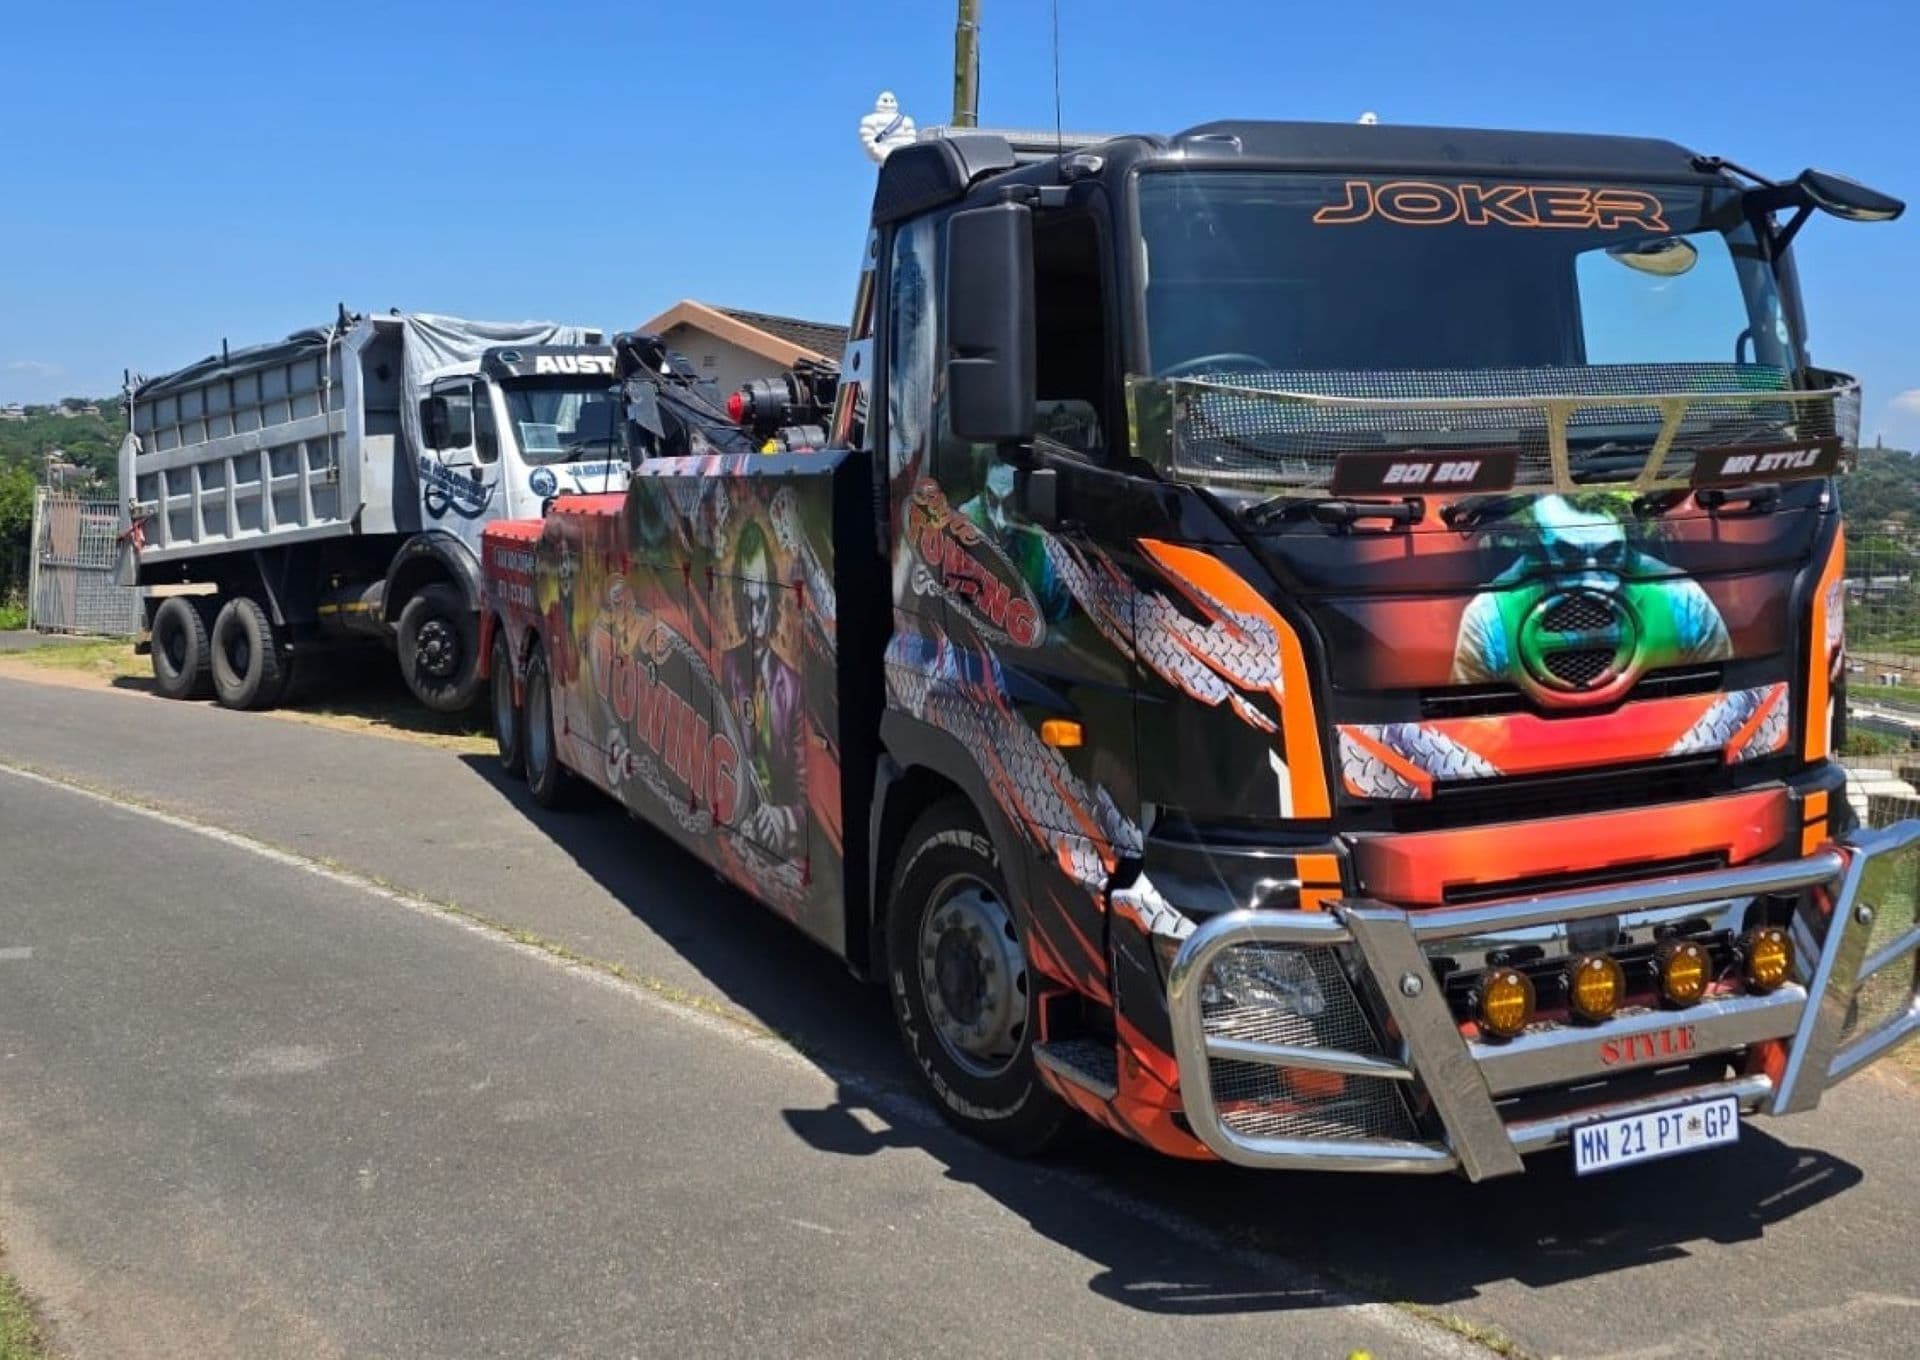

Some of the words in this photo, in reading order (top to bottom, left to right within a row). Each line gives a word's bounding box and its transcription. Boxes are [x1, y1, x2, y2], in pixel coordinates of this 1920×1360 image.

[1313, 181, 1671, 231] JOKER
[536, 355, 616, 375] AUST
[1382, 463, 1434, 484] BOI
[1431, 461, 1482, 482] BOI
[1755, 448, 1822, 472] STYLE
[592, 622, 740, 825] TOWING
[1600, 1024, 1697, 1066] STYLE
[1581, 1127, 1610, 1165] MN
[1620, 1120, 1647, 1157] 21
[1657, 1112, 1684, 1149] PT
[1704, 1104, 1732, 1139] GP
